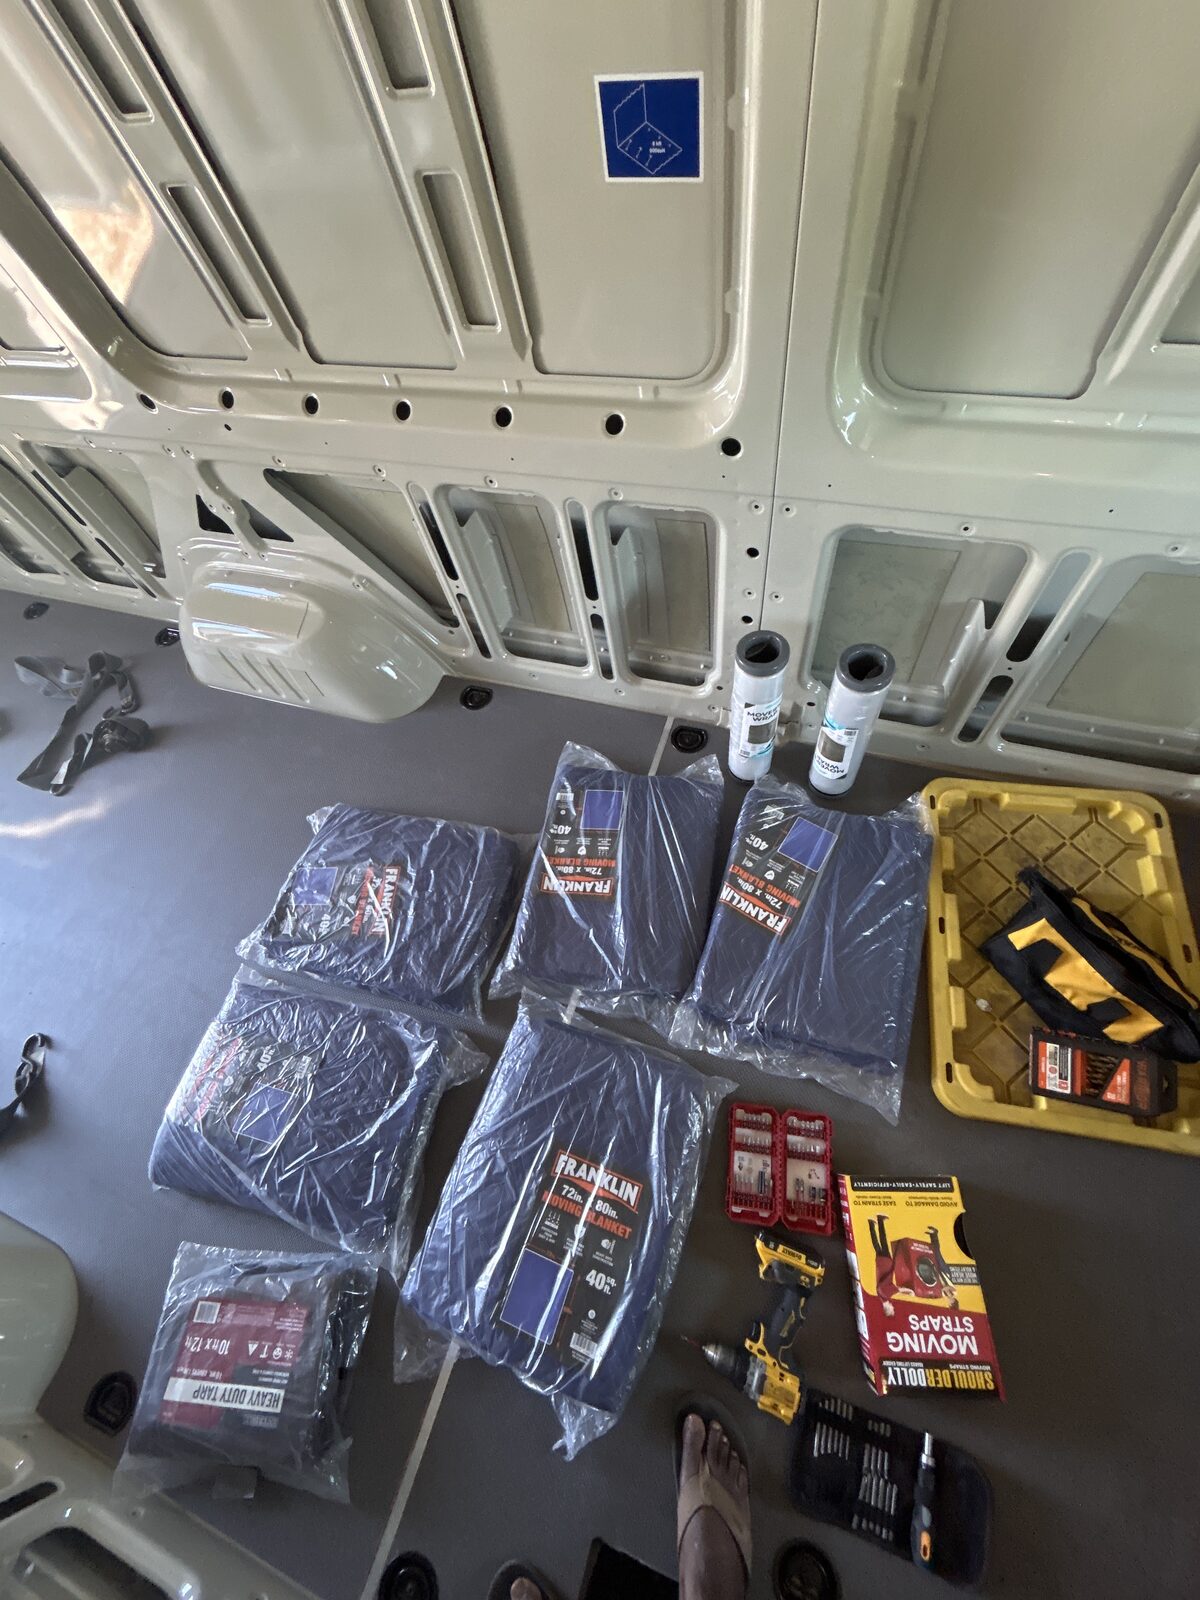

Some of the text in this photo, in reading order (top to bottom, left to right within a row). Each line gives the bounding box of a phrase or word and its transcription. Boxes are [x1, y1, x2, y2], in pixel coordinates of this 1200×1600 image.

[558, 825, 572, 835] 40
[753, 837, 769, 851] 40
[547, 856, 582, 865] BLANKE
[729, 864, 765, 888] BLANKET
[720, 884, 787, 932] FRANKLIN
[554, 1154, 639, 1206] FRANKLIN
[562, 1185, 583, 1203] 72in.
[595, 1200, 618, 1219] 80in.
[586, 1269, 605, 1290] 40
[908, 1314, 974, 1332] STRAPS
[886, 1332, 979, 1355] MOVING
[192, 1384, 281, 1408] HEAVY DUTY TARP
